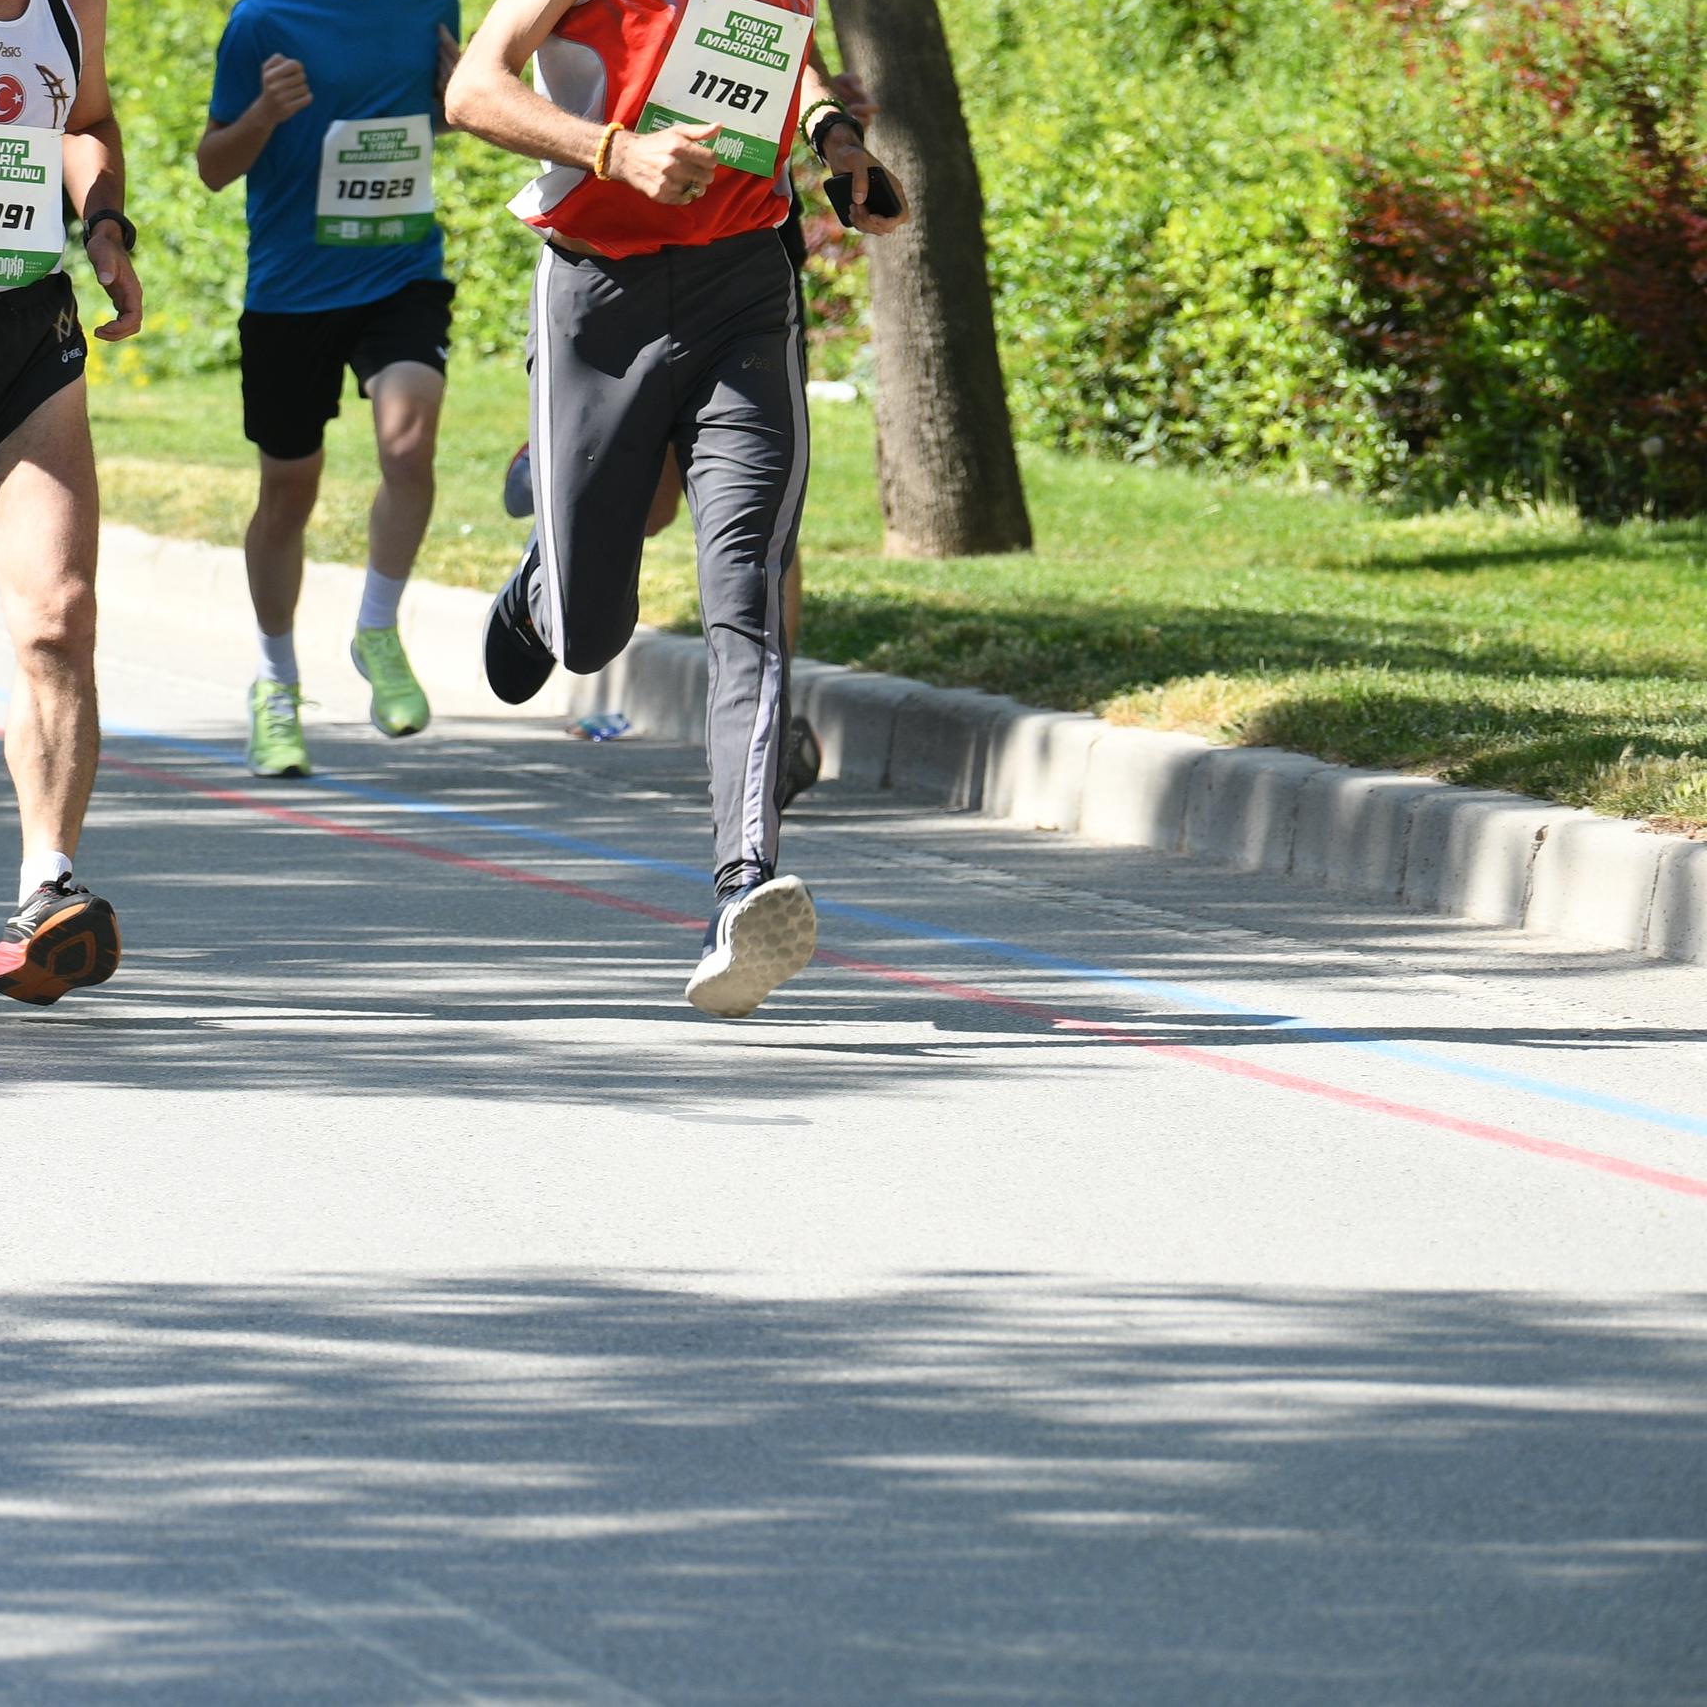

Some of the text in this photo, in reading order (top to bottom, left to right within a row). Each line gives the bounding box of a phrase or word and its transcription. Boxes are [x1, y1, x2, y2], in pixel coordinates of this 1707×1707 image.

[730, 15, 779, 39] KONYA
[735, 28, 768, 49] YARI
[702, 33, 786, 68] MARATONU
[689, 70, 769, 114] 11787
[337, 178, 416, 200] 10929
